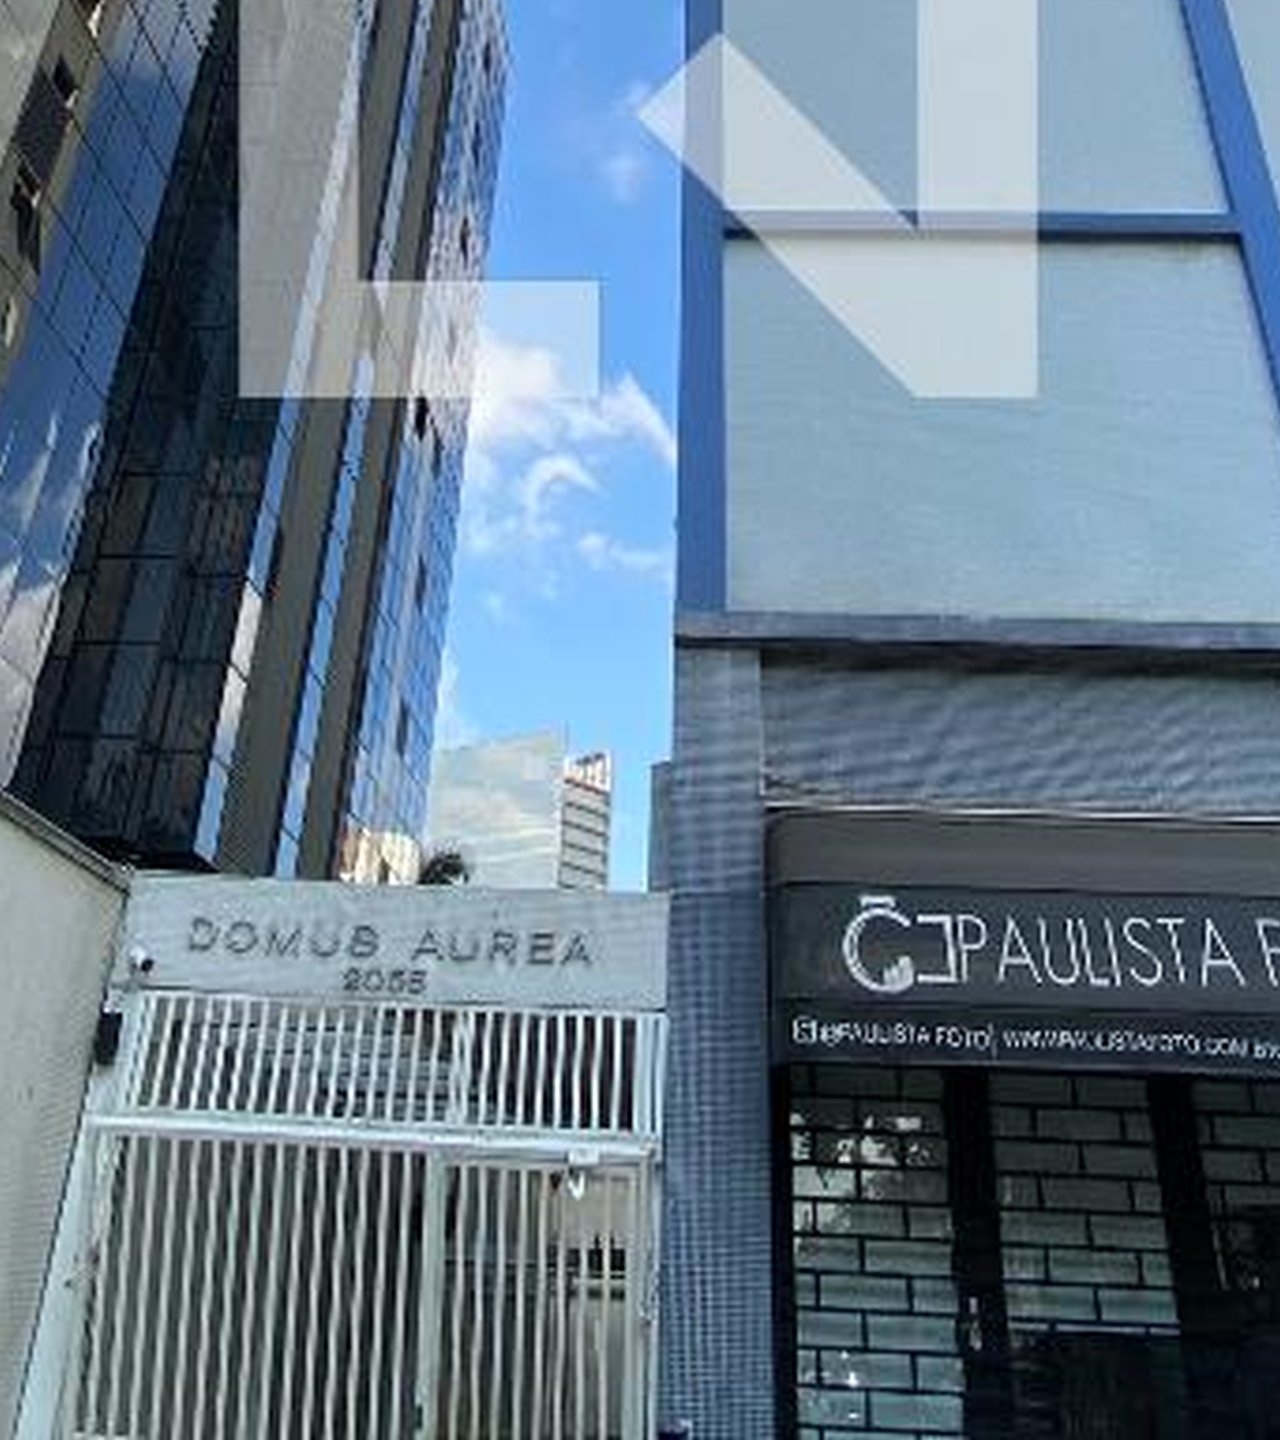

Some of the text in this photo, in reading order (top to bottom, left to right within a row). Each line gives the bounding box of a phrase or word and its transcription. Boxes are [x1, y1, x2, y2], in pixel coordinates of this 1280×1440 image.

[188, 916, 593, 967] DOMUS AUREA
[959, 913, 1245, 988] PAULISTA
